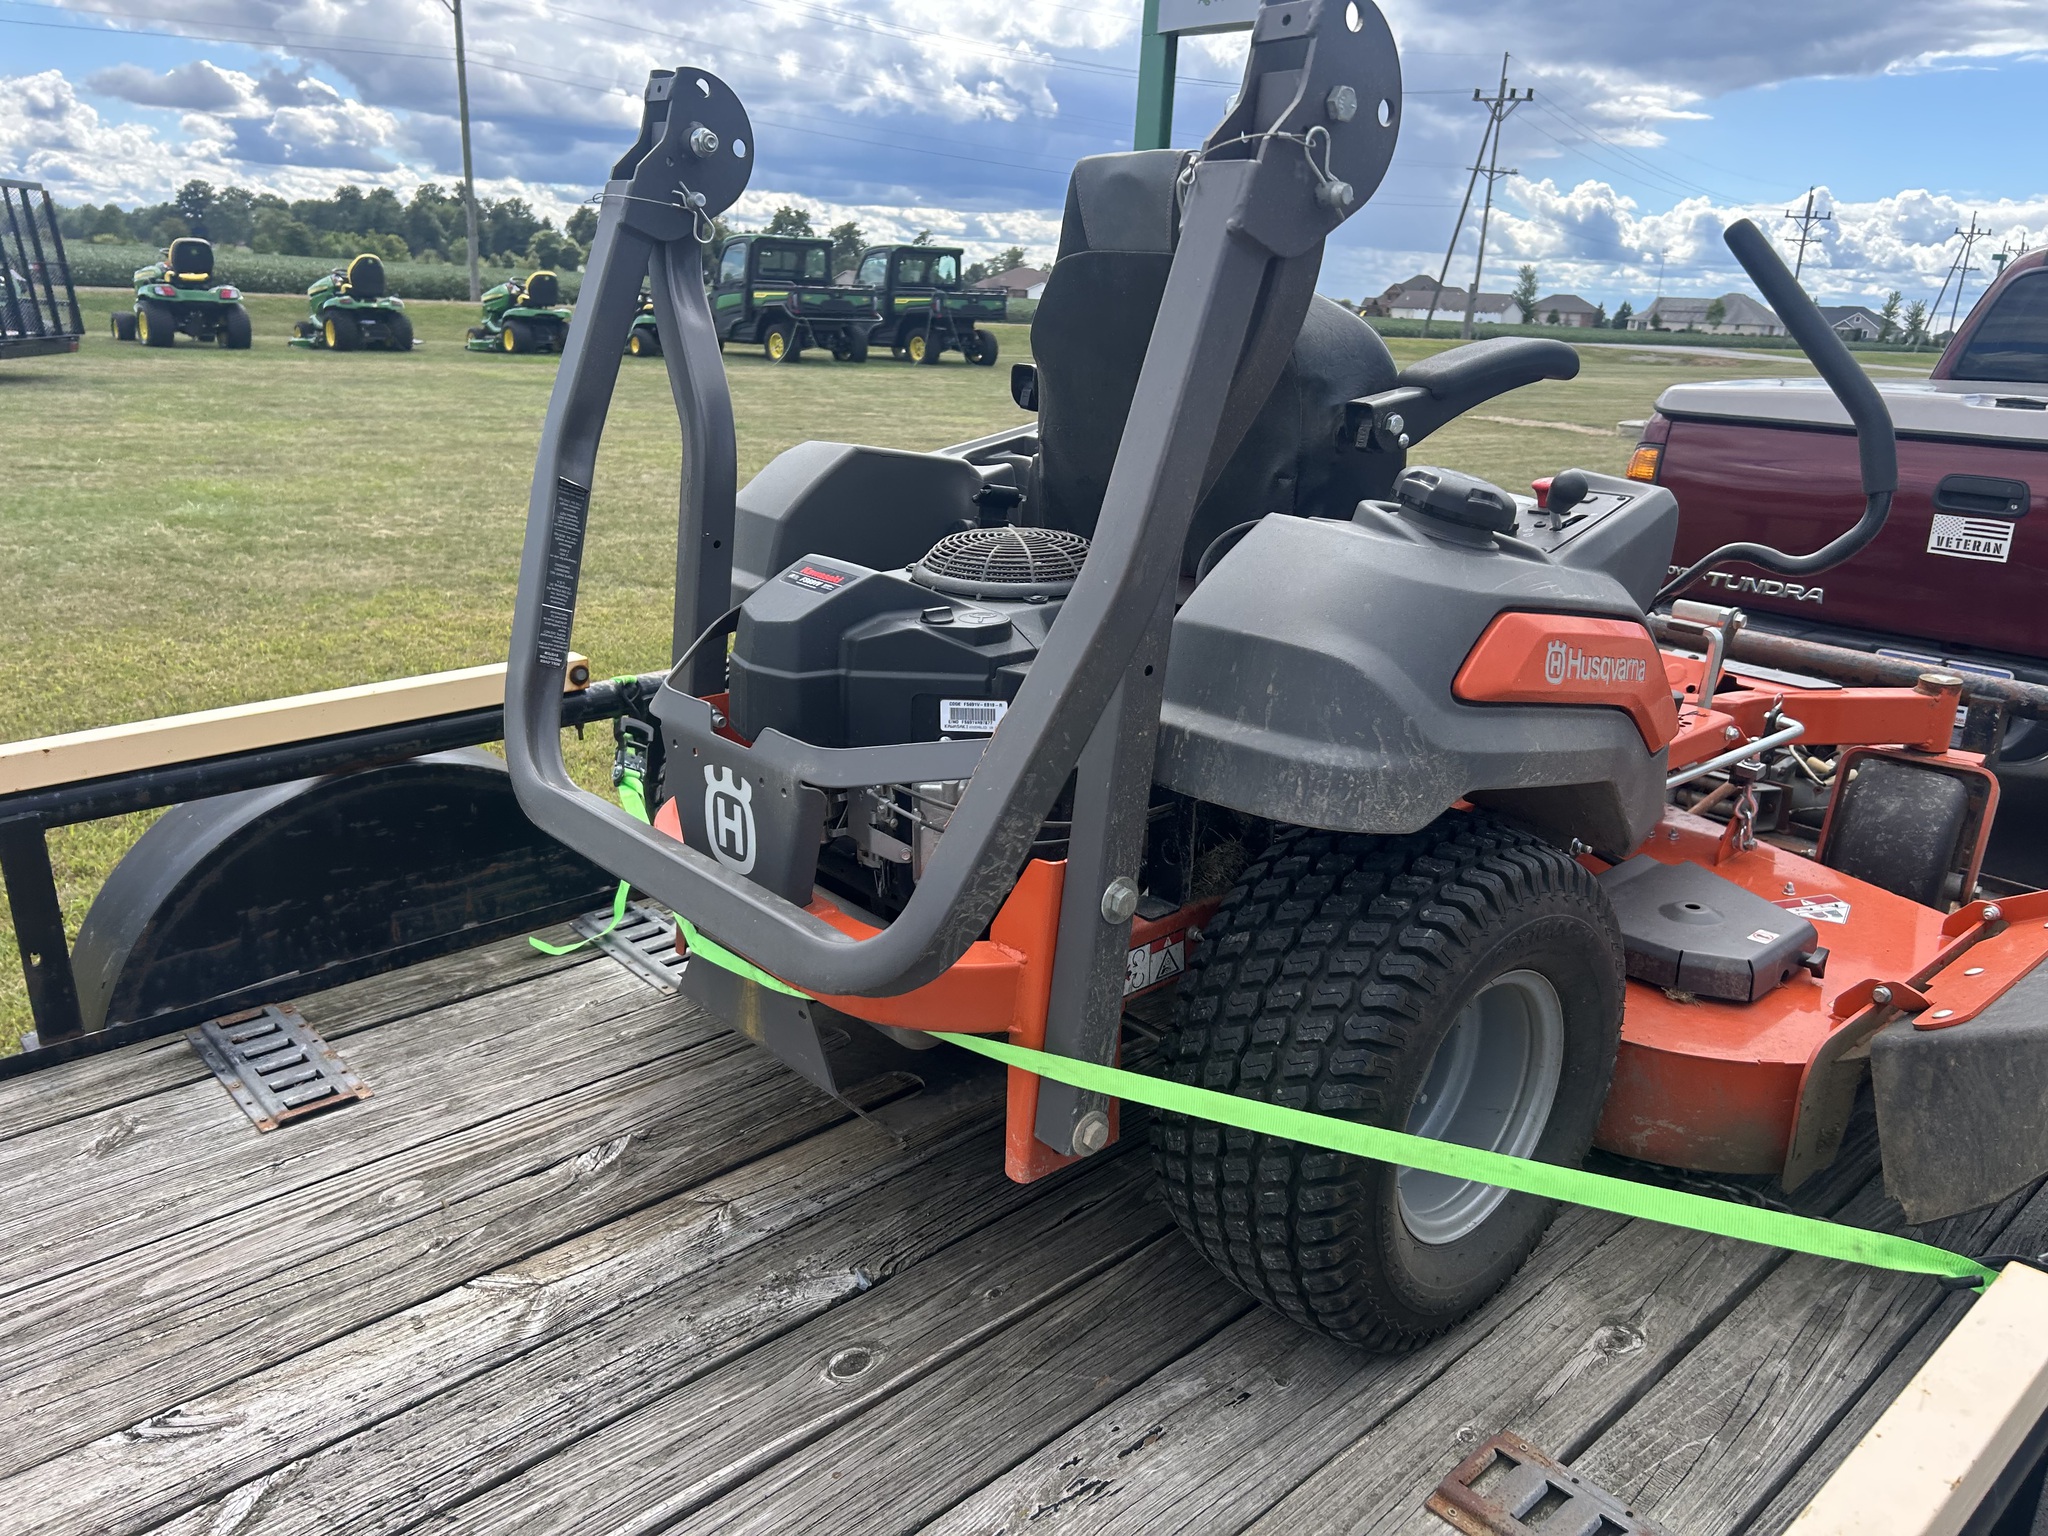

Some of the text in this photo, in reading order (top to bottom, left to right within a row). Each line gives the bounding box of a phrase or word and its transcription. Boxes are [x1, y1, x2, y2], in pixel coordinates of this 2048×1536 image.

[1936, 536, 2003, 555] VETERAN
[1706, 570, 1824, 605] TUNDRA
[1566, 644, 1647, 686] Husqvarna
